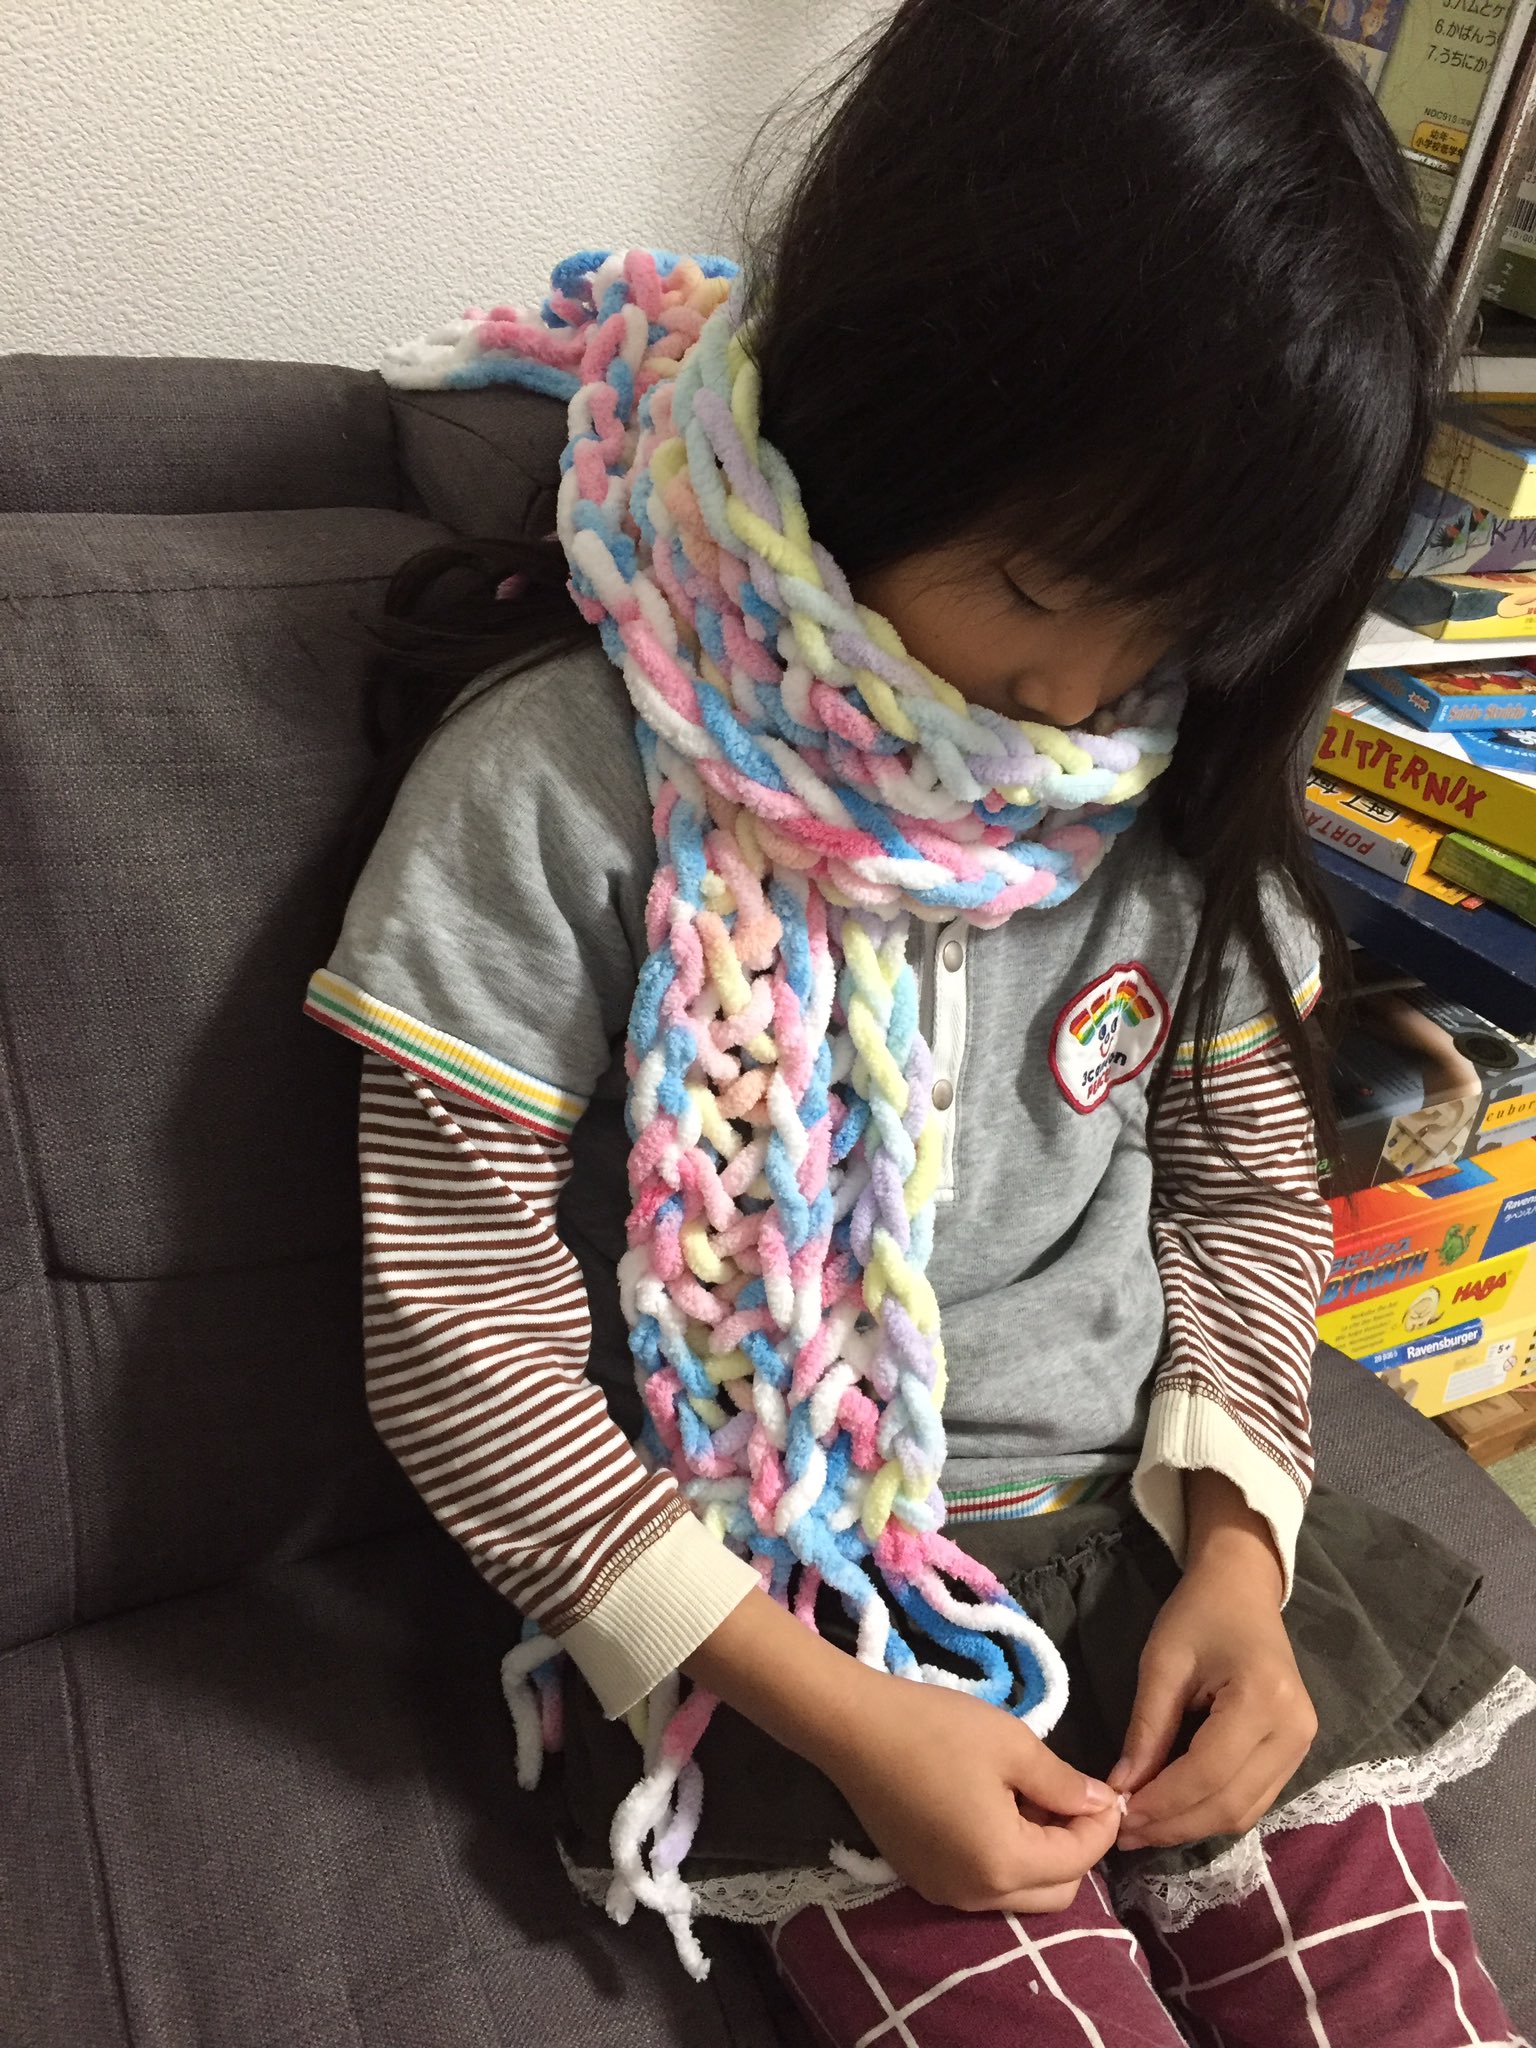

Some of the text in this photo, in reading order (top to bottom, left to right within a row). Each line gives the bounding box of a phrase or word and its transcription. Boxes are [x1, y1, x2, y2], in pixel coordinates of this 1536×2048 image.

[1317, 726, 1488, 819] ZITTERNIX
[1303, 809, 1376, 856] PORTA
[1452, 1272, 1507, 1305] HABA
[1406, 1328, 1478, 1360] Ravensburger
